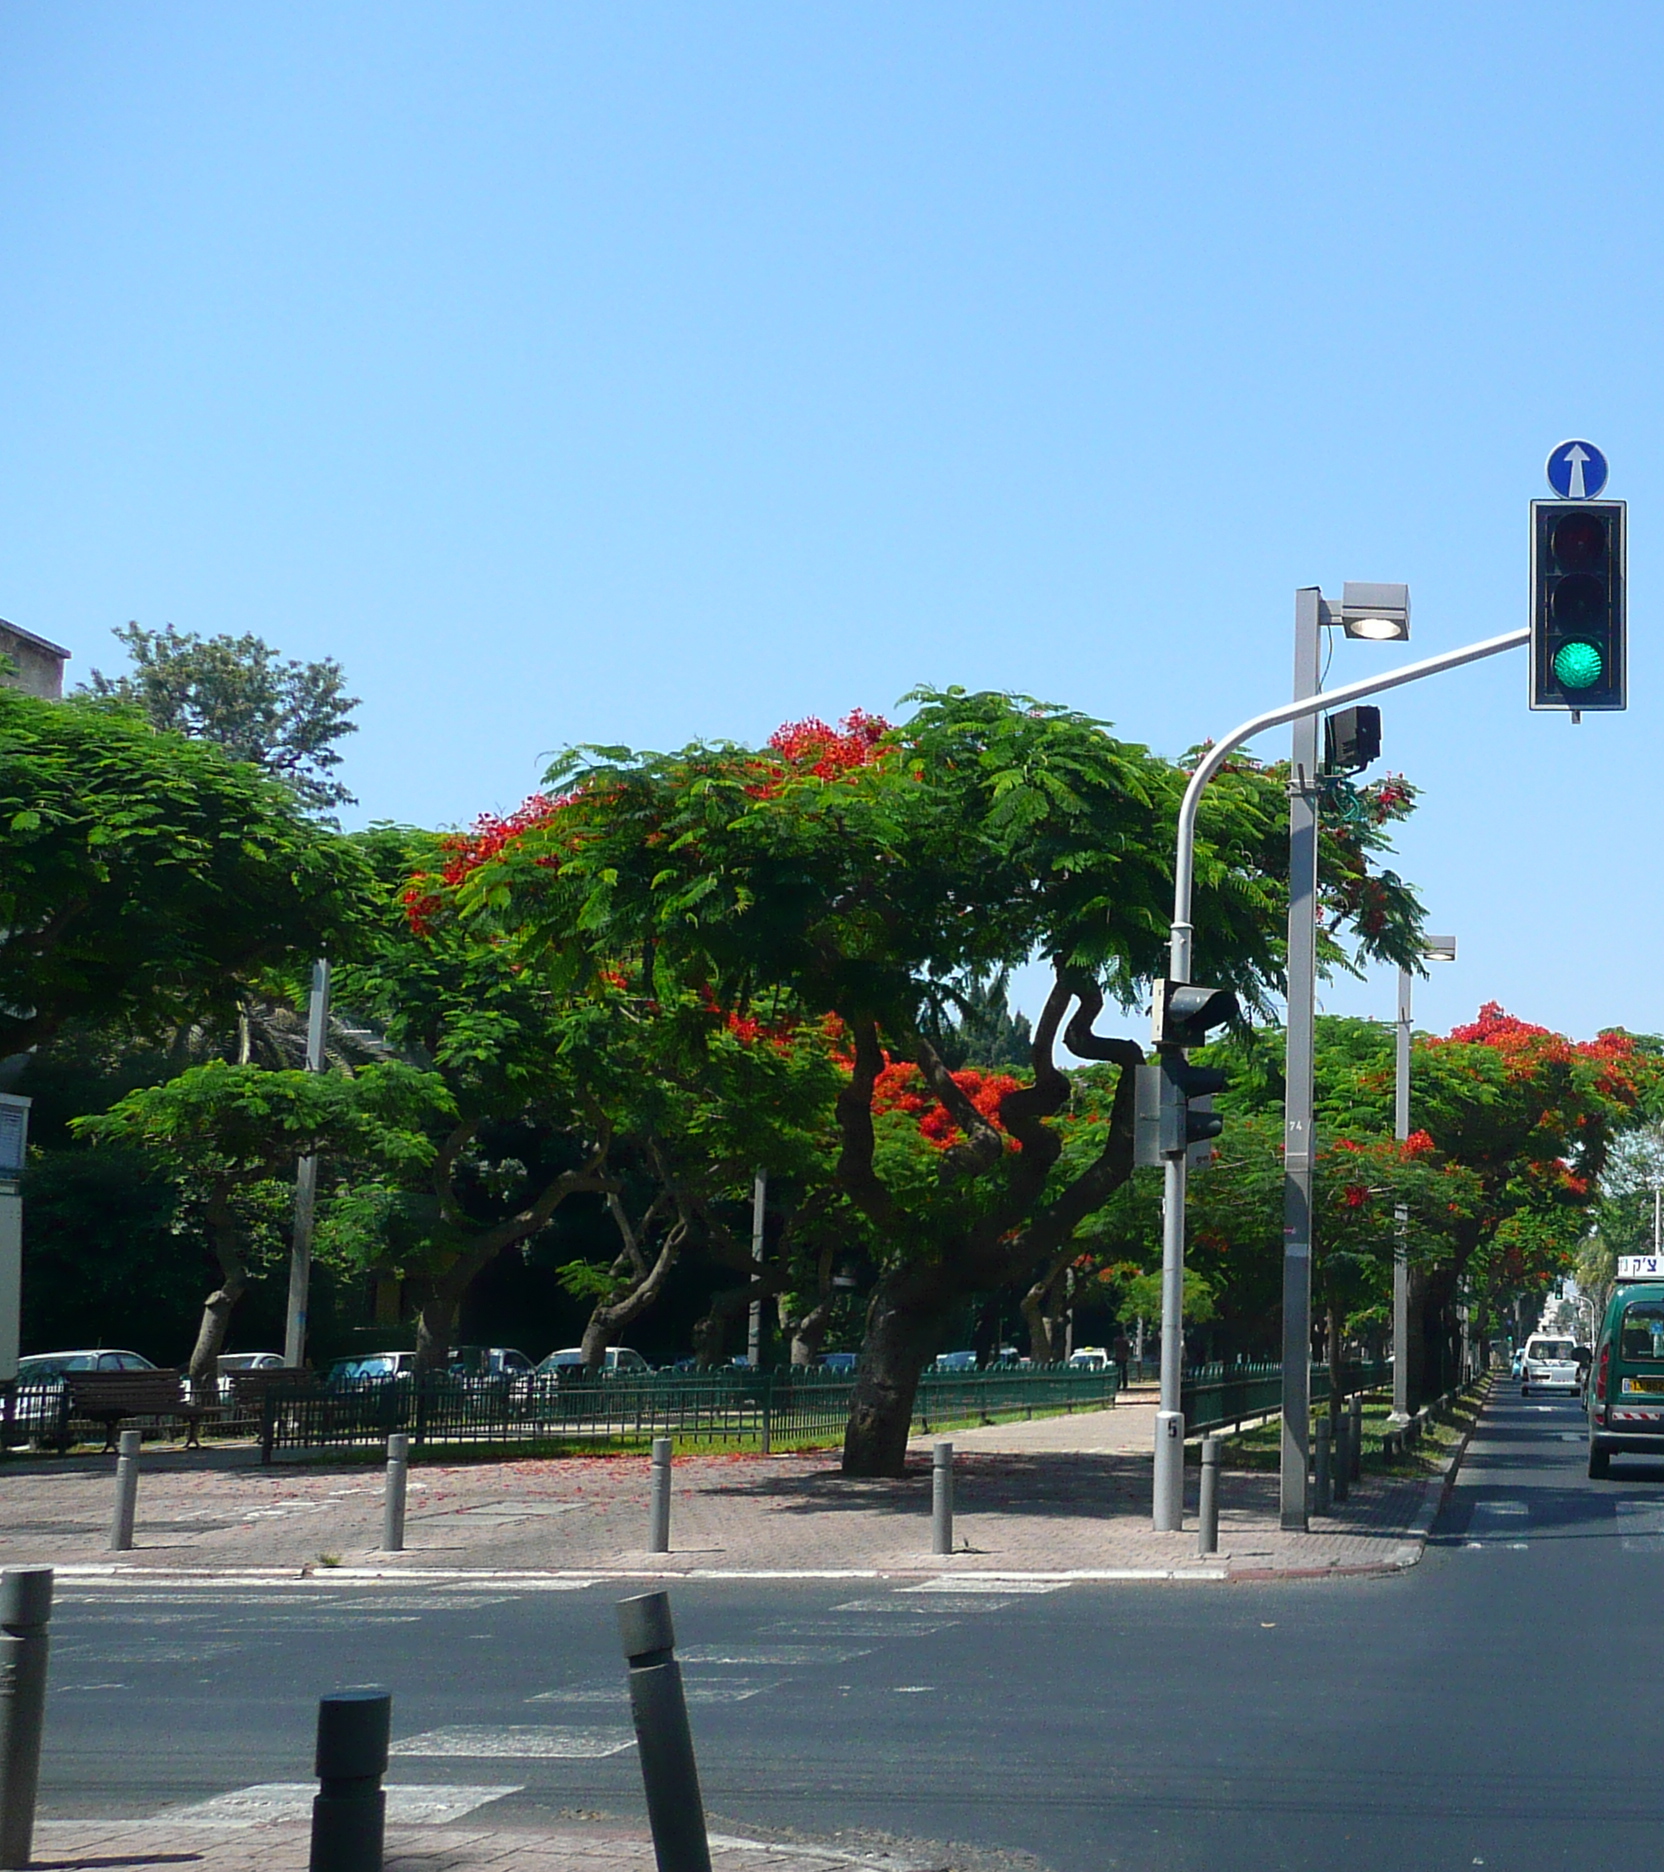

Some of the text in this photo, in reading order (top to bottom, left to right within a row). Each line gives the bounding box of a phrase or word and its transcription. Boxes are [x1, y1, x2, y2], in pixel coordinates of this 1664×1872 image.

[1289, 1121, 1302, 1131] 74
[1633, 1257, 1657, 1277] צ'ק
[1168, 1419, 1178, 1437] 5
